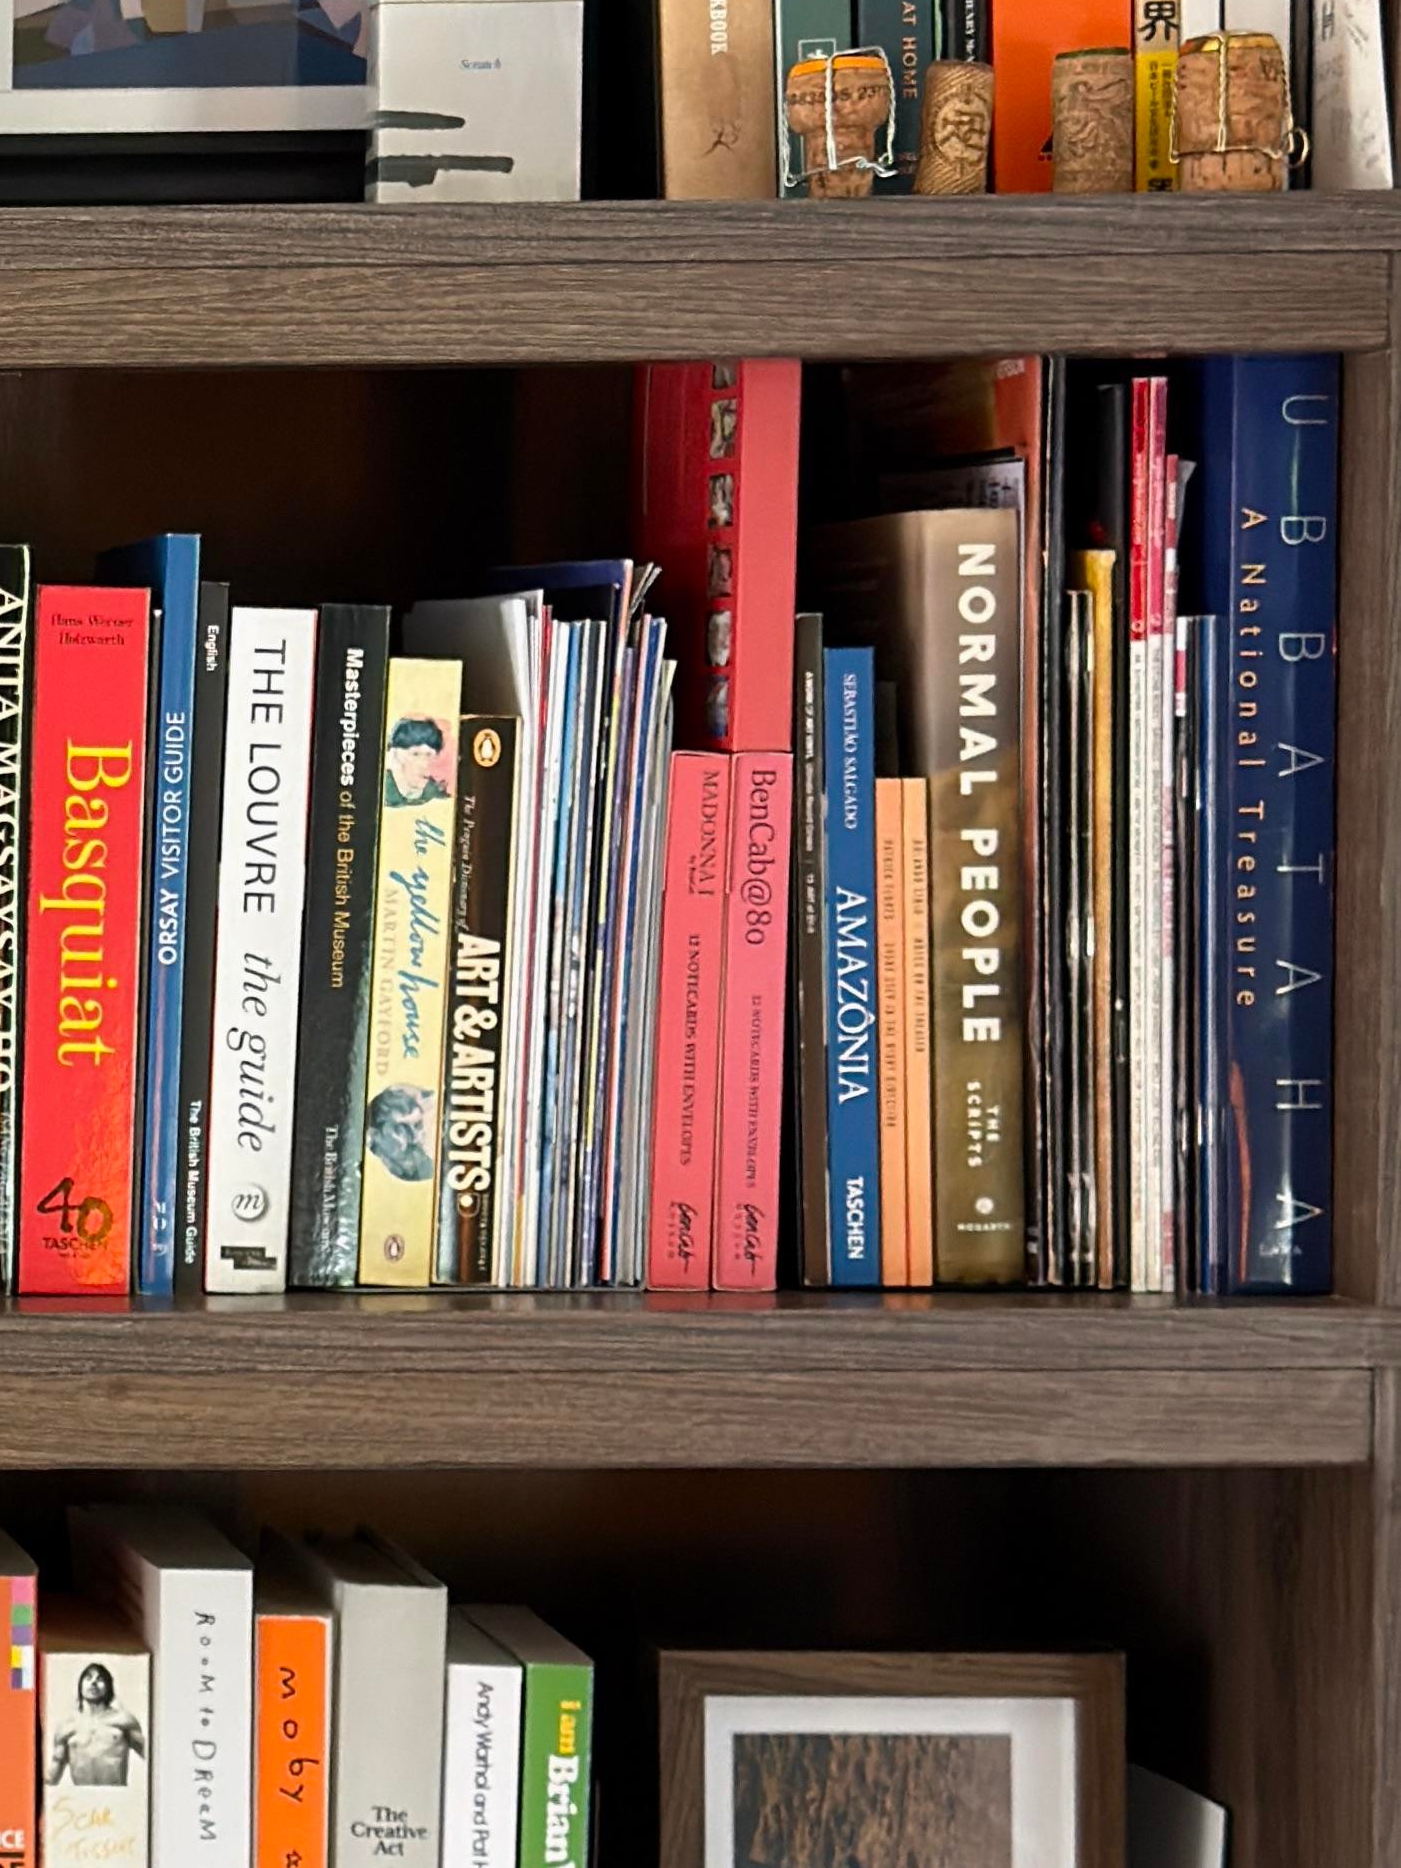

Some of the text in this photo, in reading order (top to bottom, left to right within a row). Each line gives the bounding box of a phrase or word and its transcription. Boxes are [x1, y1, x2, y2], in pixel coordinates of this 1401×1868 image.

[157, 711, 187, 966] ORSAY VISITOR GUIDE
[244, 638, 286, 914] THE LOUVRE
[957, 542, 1000, 1044] NORMAL PEOPLE
[1237, 507, 1266, 1008] A National Treasure
[39, 738, 133, 1068] Basquiat
[835, 886, 875, 1103] AMAZÔNIA
[226, 955, 277, 1150] the guide
[350, 1823, 427, 1841] Creative
[371, 1806, 408, 1823] The
[371, 1840, 404, 1857] Act
